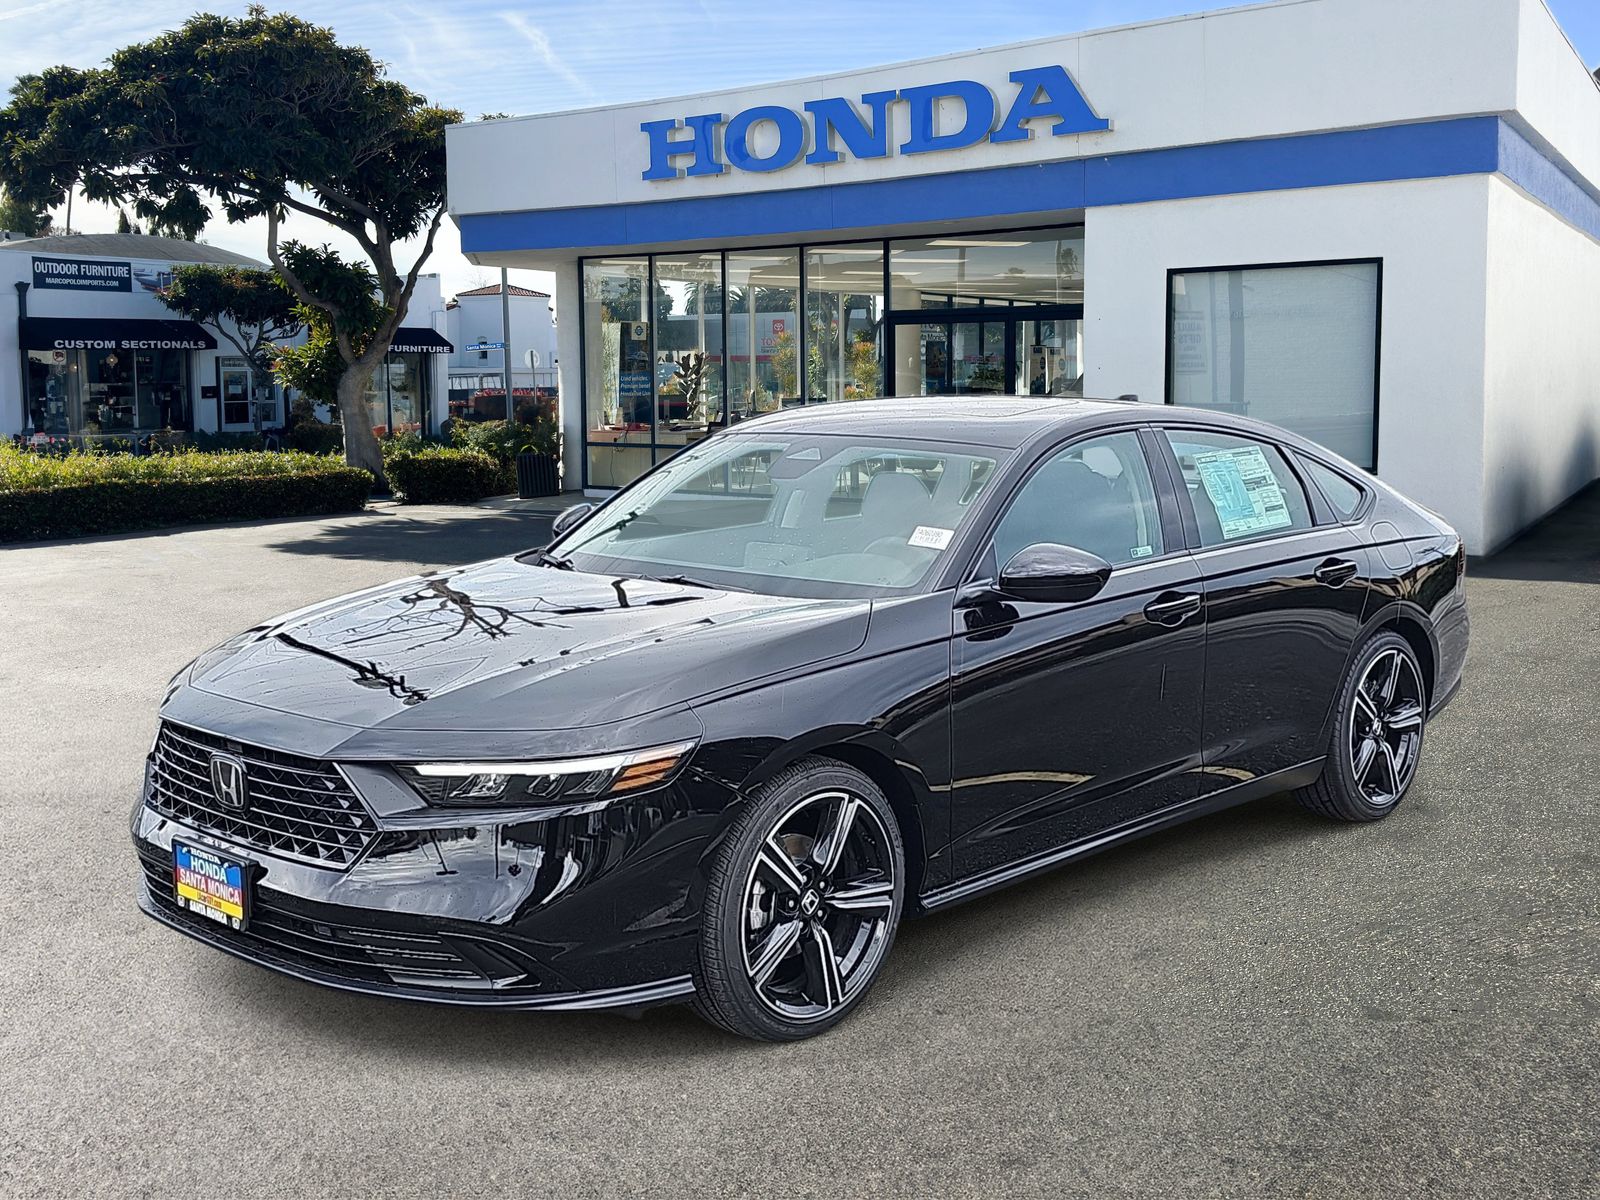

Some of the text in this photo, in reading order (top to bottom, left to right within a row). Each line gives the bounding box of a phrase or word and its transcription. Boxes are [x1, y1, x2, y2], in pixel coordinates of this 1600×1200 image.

[641, 65, 1113, 181] HONDA
[34, 261, 129, 278] OUTDOOR FURNITURE
[45, 277, 119, 287] MARCOPOLOIMPORTS.COM
[54, 339, 206, 349] CUSTOM SECTIONALS
[388, 344, 450, 353] FURNITURE
[189, 847, 221, 865] HONDA
[190, 855, 228, 884] HONDA
[179, 868, 207, 893] SANTA
[207, 878, 241, 905] MONICA
[189, 899, 207, 916] SANTA
[207, 905, 228, 925] MONICA
